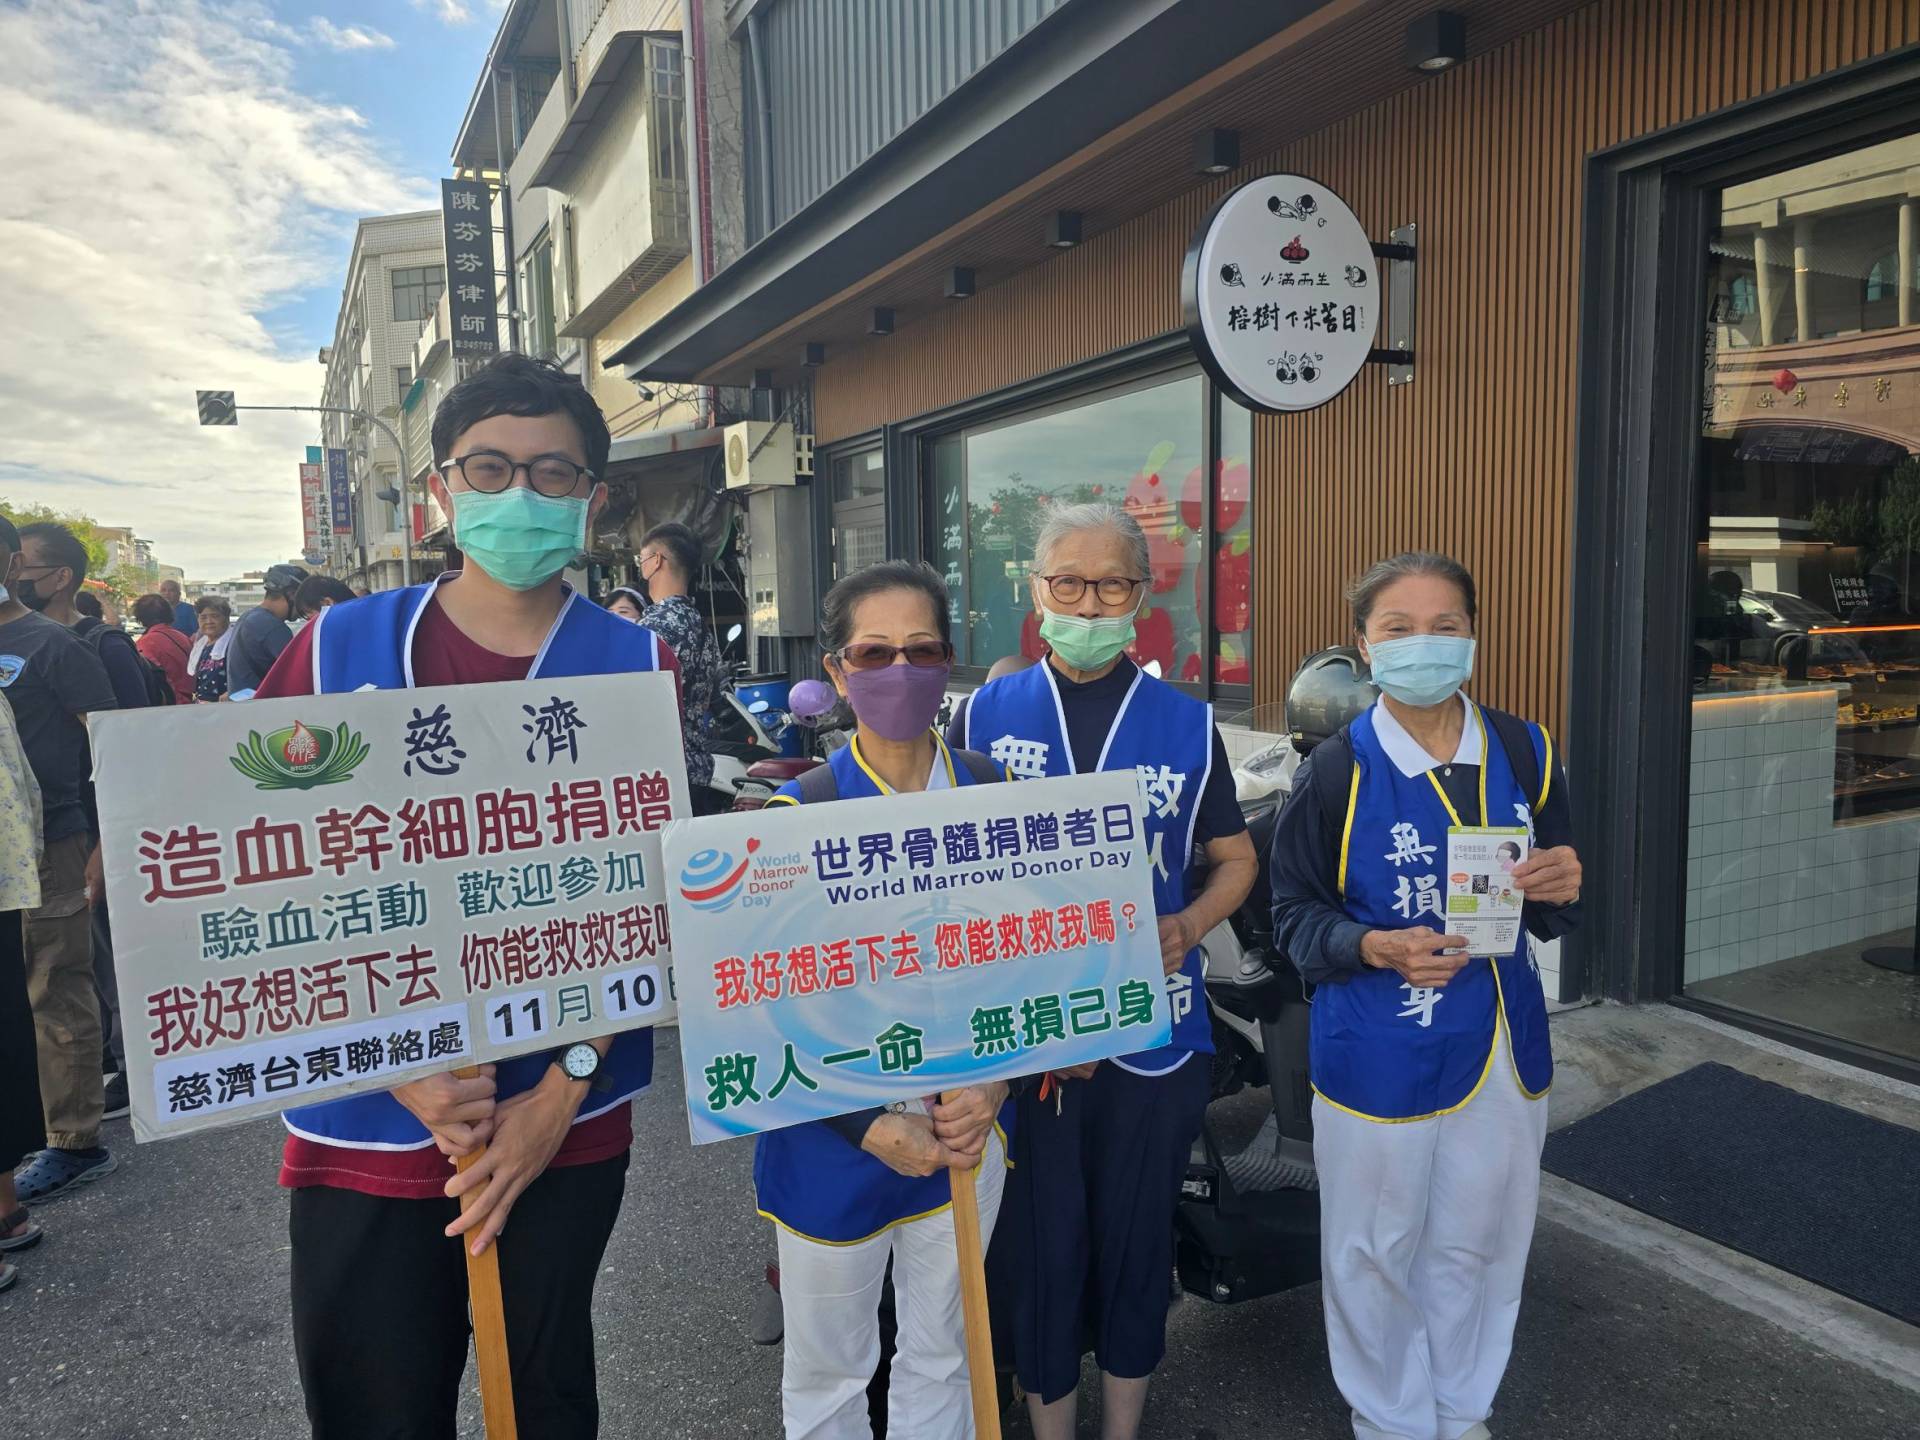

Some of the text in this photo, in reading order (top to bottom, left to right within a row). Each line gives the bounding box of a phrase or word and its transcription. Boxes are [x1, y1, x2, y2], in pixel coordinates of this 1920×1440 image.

[451, 191, 487, 334] 陳芬芬律師
[403, 695, 587, 776] 慈濟
[137, 770, 673, 903] 造血幹細胞捐贈
[752, 864, 810, 881] Marrow
[755, 852, 801, 869] World
[811, 803, 1135, 882] 世界骨髓捐贈者日
[827, 848, 1132, 905] World Marrow Donor Day
[200, 851, 647, 961] 驗血活動 歡迎參加
[741, 894, 773, 909] Day
[748, 879, 795, 895] Donor
[147, 944, 443, 1057] 我好想活下去
[713, 931, 923, 1010] 我好想活下去
[168, 1020, 465, 1115] 慈濟台東聯絡處
[704, 979, 1156, 1113] 救人一命 無損己身
